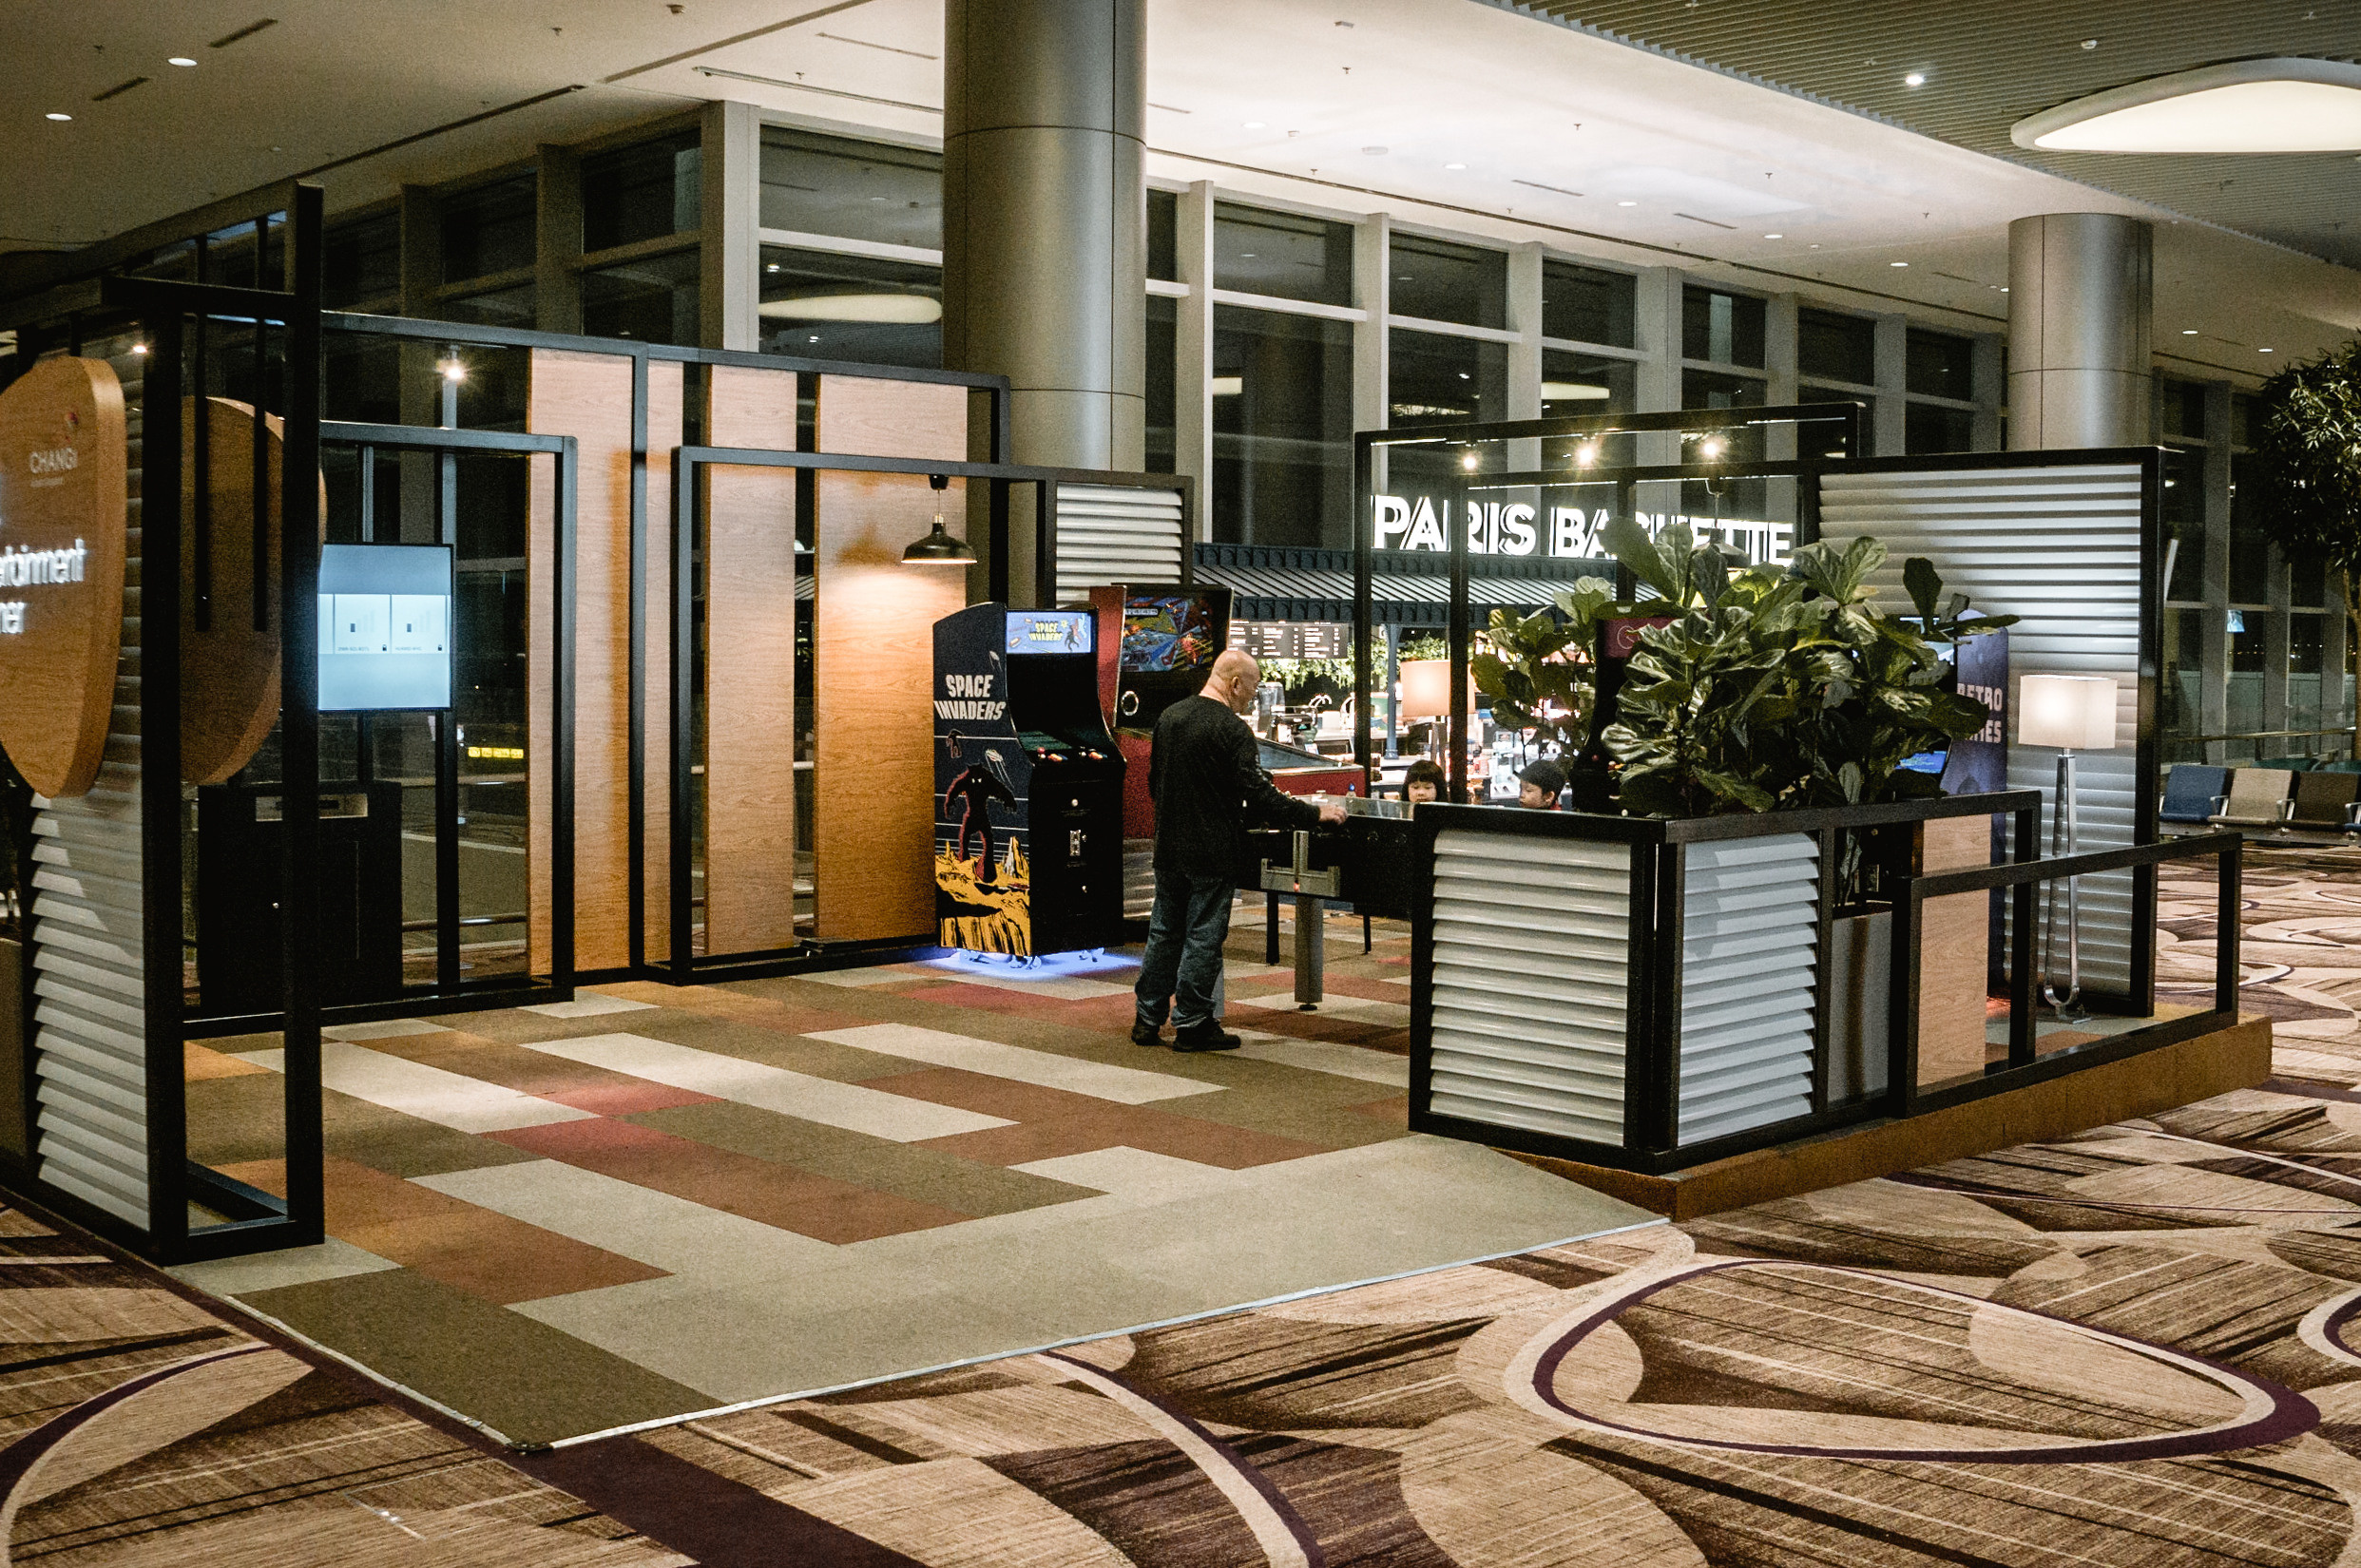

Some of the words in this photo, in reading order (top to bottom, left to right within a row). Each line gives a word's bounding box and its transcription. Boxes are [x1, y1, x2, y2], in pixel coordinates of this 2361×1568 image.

[30, 447, 78, 474] CHANGI
[1371, 494, 1537, 556] PARIS
[1548, 507, 1795, 567] BAETTE
[1028, 631, 1064, 641] INVADERS
[1035, 621, 1059, 633] SPACE
[945, 674, 994, 698] SPACE
[933, 700, 1007, 720] INVADERS
